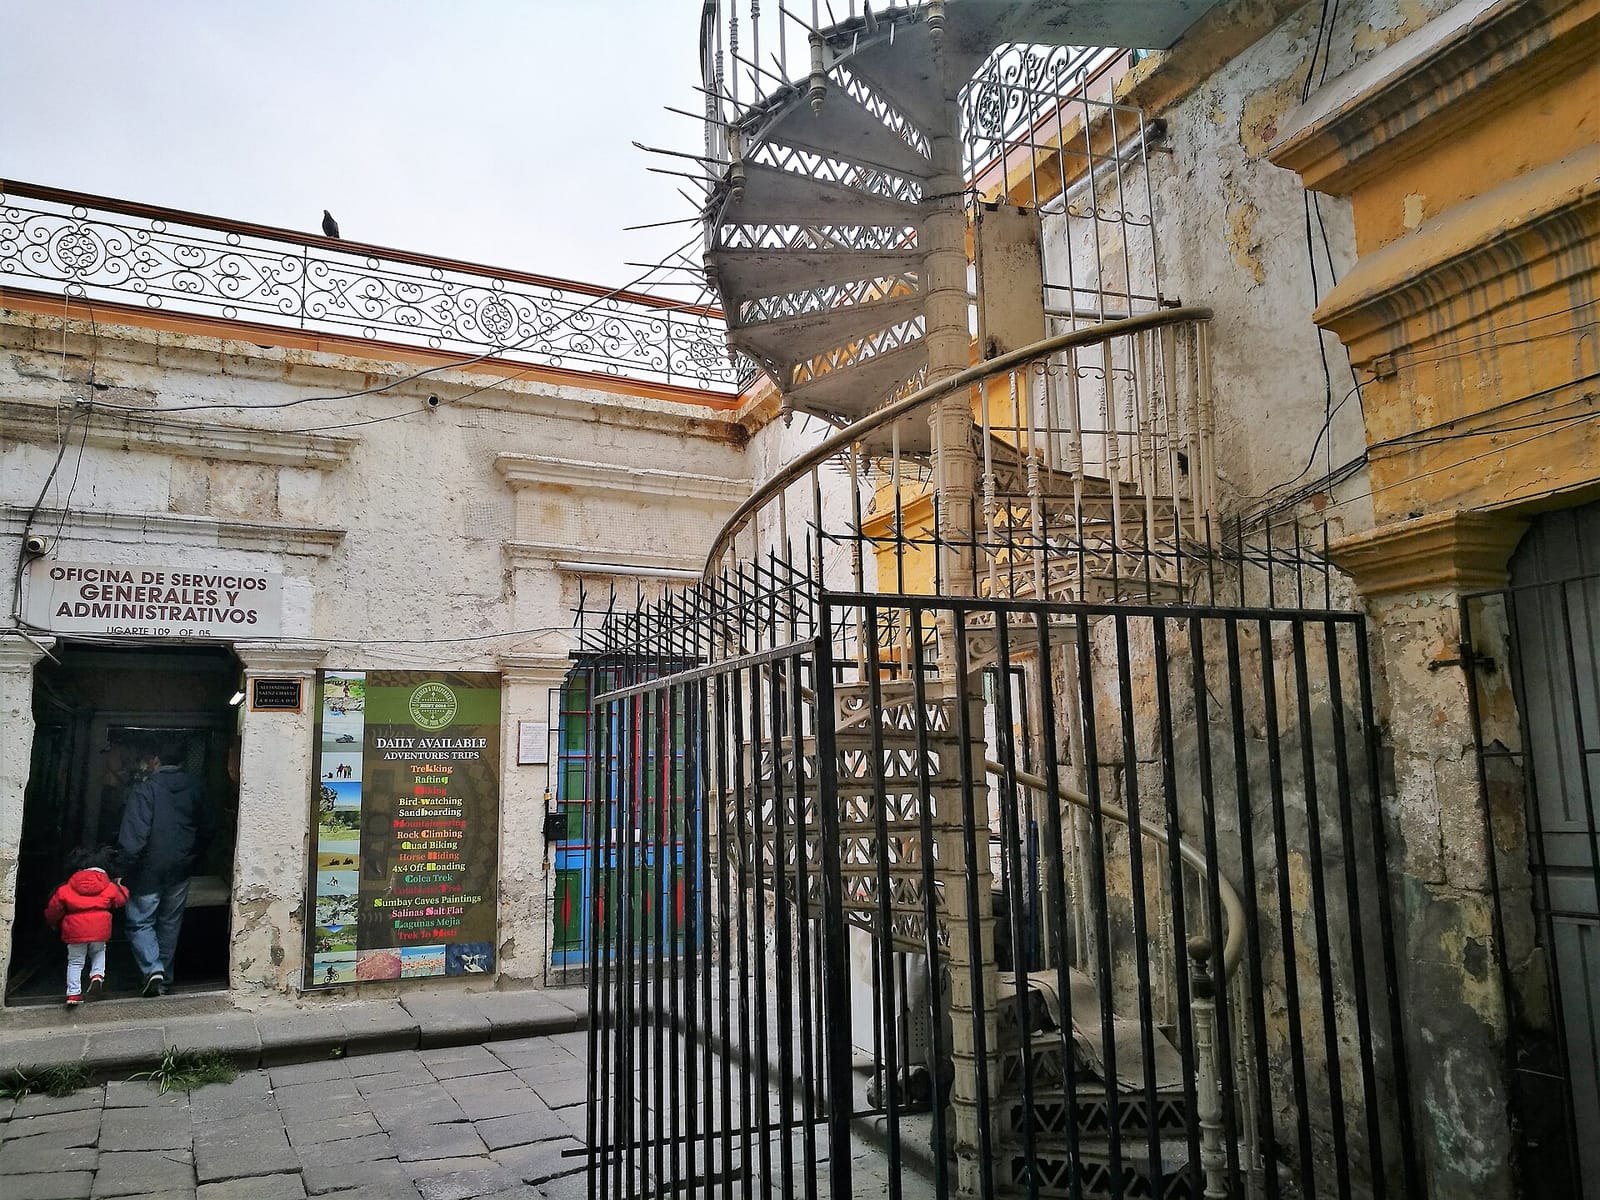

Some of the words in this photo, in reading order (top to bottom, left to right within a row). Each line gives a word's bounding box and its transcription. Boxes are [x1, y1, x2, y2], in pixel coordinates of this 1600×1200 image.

[50, 567, 134, 584] OFICINA
[141, 571, 165, 586] DE
[171, 573, 267, 591] SERVICIOS
[80, 584, 218, 606] GENERALES
[226, 591, 240, 606] Y
[56, 602, 258, 624] ADMINISTRATIVOS
[106, 626, 149, 636] UGARTE
[152, 628, 170, 636] 109
[376, 738, 415, 749] DAILY
[418, 738, 487, 749] AVAILABLE
[384, 752, 450, 760] ADVENTURES
[451, 751, 480, 759] TRIPS
[411, 764, 453, 774] Trekking
[415, 776, 449, 784] Rafting
[399, 797, 462, 806] Bird-watching
[399, 808, 462, 817] Sandboarding
[397, 831, 420, 839] Rock
[421, 829, 463, 838] Climbing
[401, 841, 427, 850] Quad
[429, 840, 458, 850] Biking
[410, 862, 466, 872] Off-Roading
[404, 874, 431, 883] Colca
[432, 873, 453, 882] Trek
[374, 897, 413, 907] Sumbay
[414, 897, 439, 905] Caves
[441, 894, 482, 904] Paintings
[392, 909, 424, 918] Salinas
[425, 907, 445, 916] Salt
[447, 906, 464, 914] Flat
[394, 920, 434, 929] Lagunas
[397, 932, 418, 940] Trek
